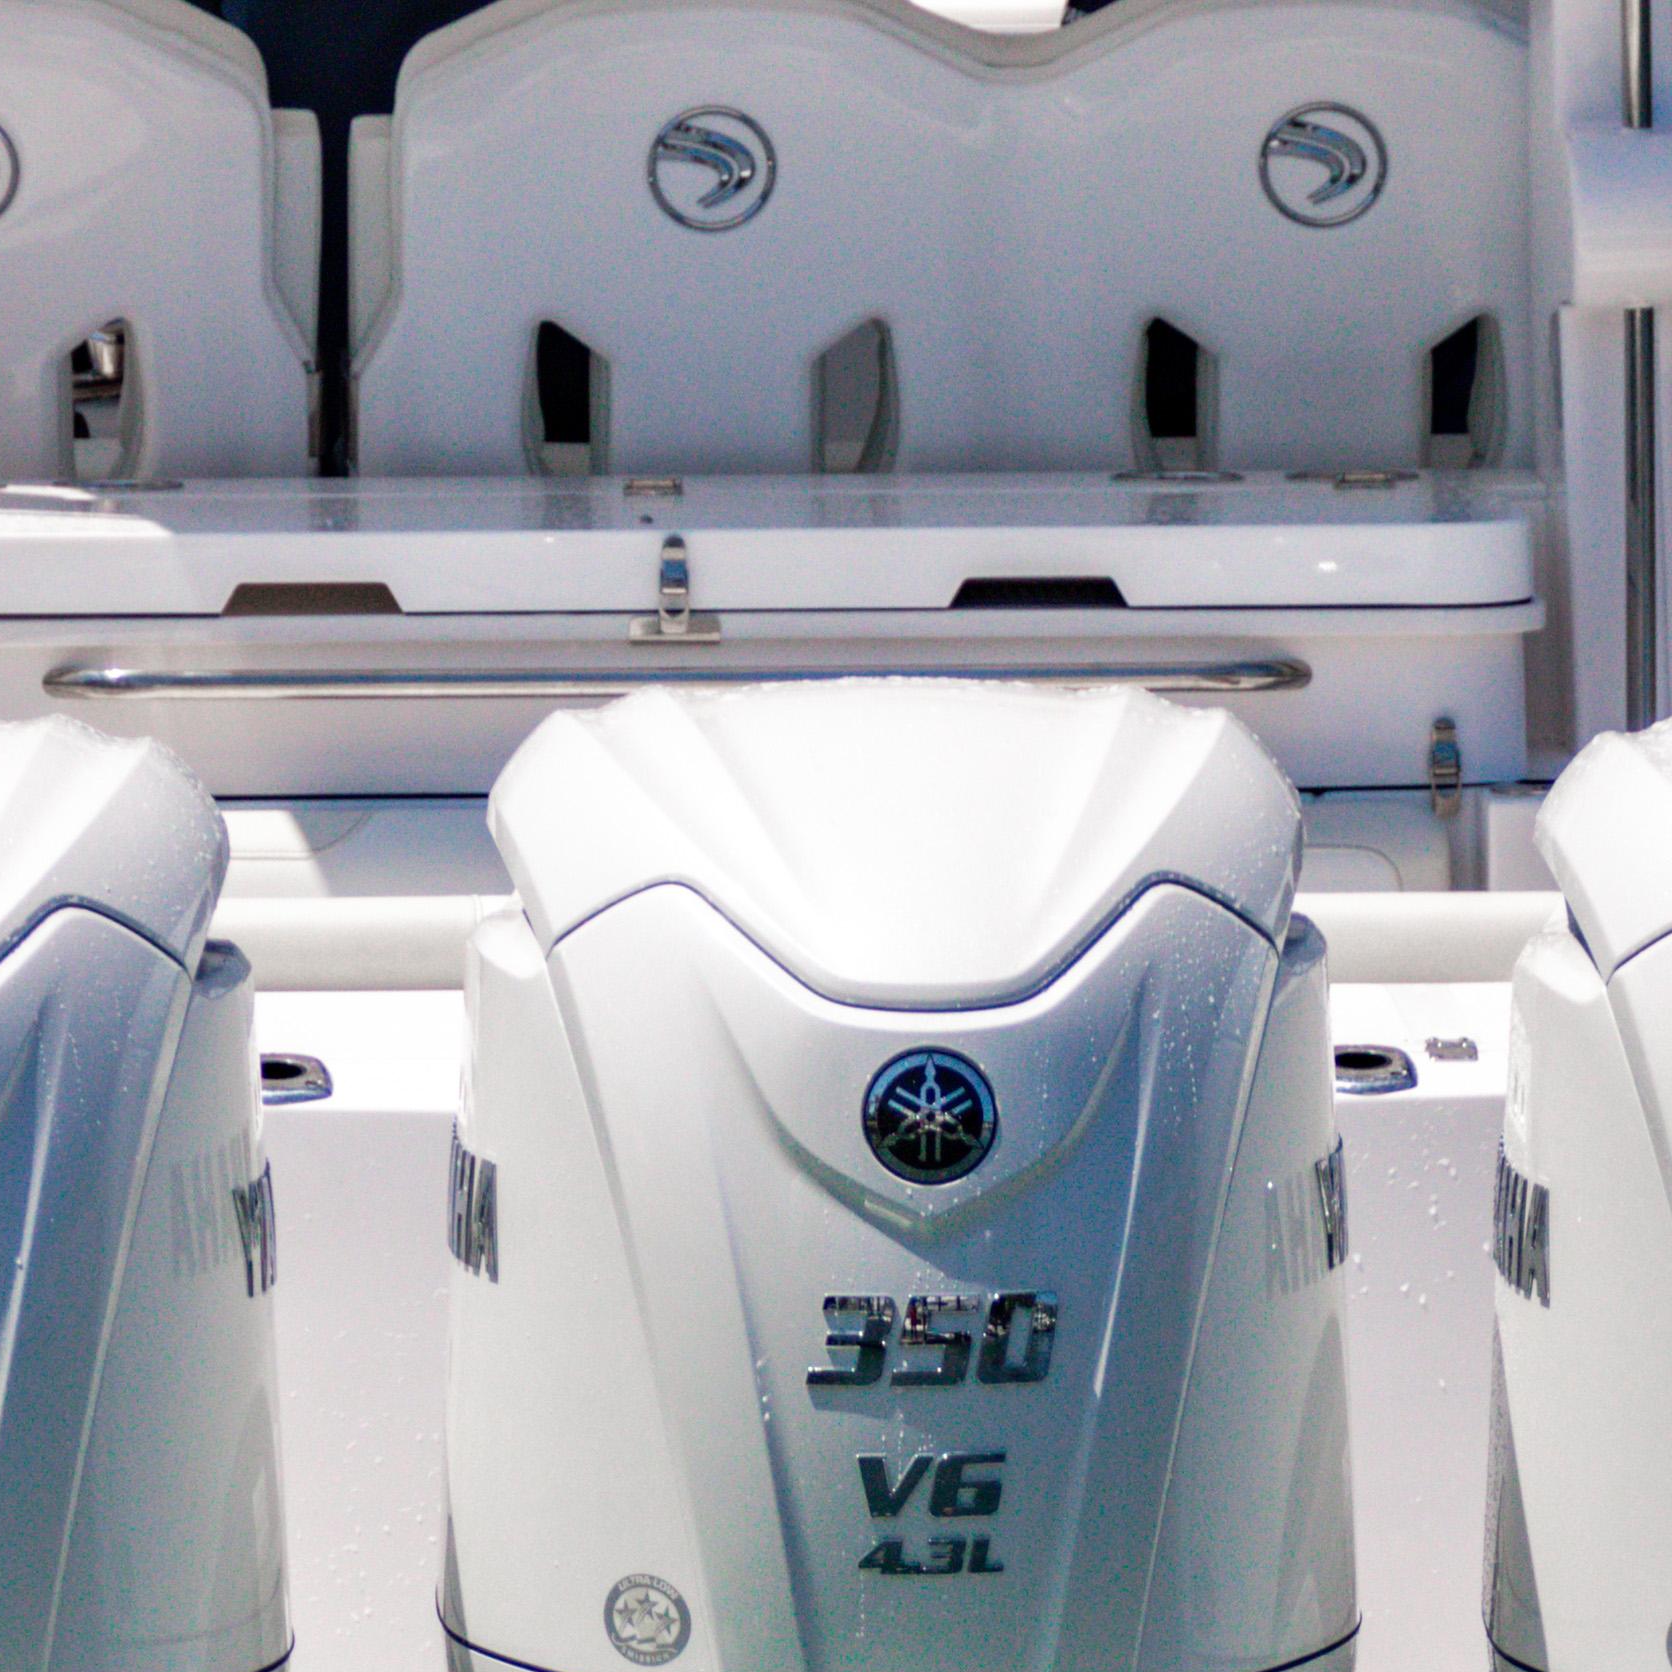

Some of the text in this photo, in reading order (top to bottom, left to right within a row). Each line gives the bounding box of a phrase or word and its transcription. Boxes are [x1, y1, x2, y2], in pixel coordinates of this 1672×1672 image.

[805, 1290, 1059, 1386] 350
[855, 1450, 1007, 1518] V6
[858, 1536, 1005, 1576] 4.3L
